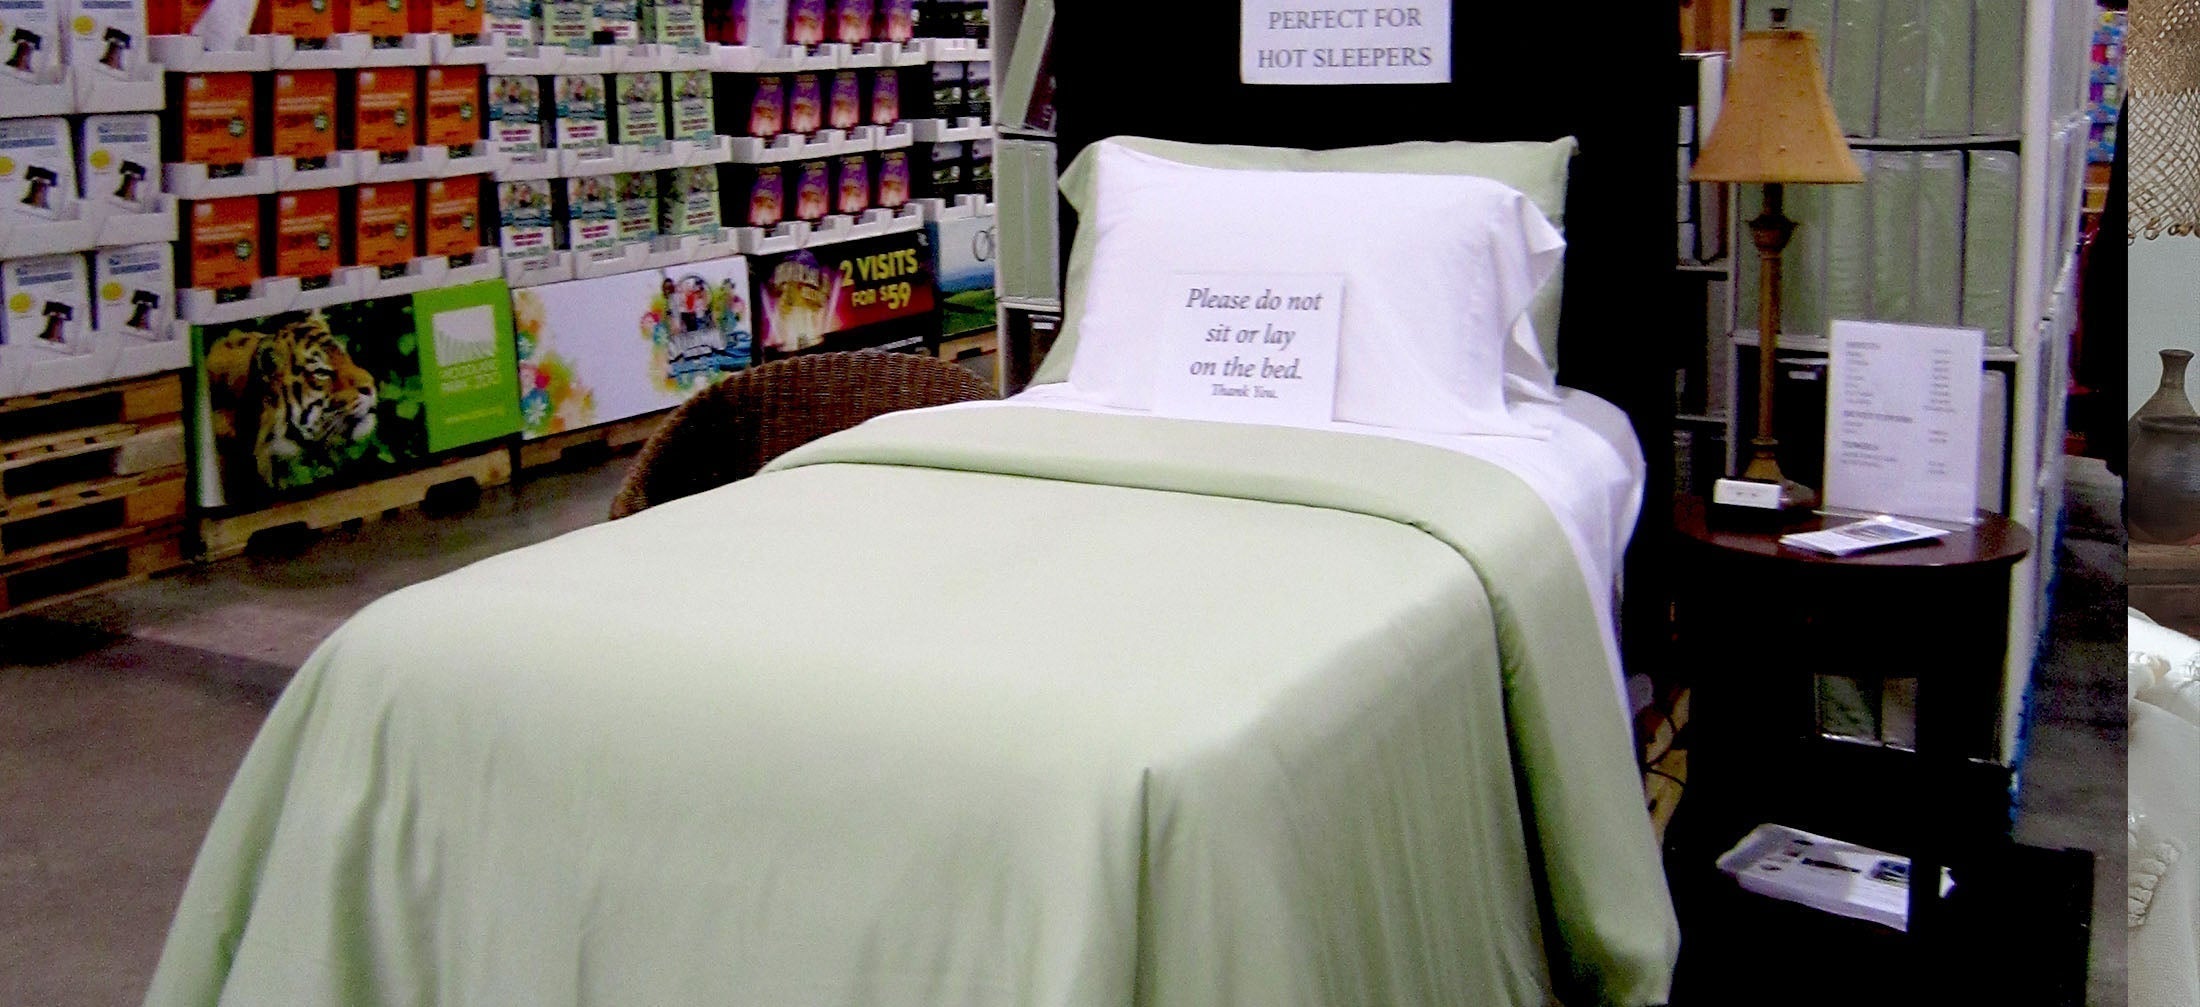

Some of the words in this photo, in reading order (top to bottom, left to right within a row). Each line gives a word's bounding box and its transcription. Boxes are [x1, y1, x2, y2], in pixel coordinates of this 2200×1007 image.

[1268, 9, 1367, 29] PERFECT
[1374, 8, 1422, 27] FOR
[1257, 49, 1307, 68] HOT
[1313, 47, 1432, 67] SLEEPERS
[839, 259, 854, 287] 2
[856, 248, 919, 283] VISITS
[852, 288, 876, 307] FOR
[880, 282, 911, 310] $59
[1185, 287, 1250, 309] Please
[1255, 288, 1282, 310] do
[1287, 292, 1324, 311] not
[1205, 323, 1232, 342] sit
[1235, 329, 1260, 343] or
[1263, 323, 1296, 351] lay
[1190, 360, 1216, 375] on
[1222, 356, 1256, 378] the
[1260, 357, 1303, 379] bed.
[1211, 384, 1250, 397] Thank
